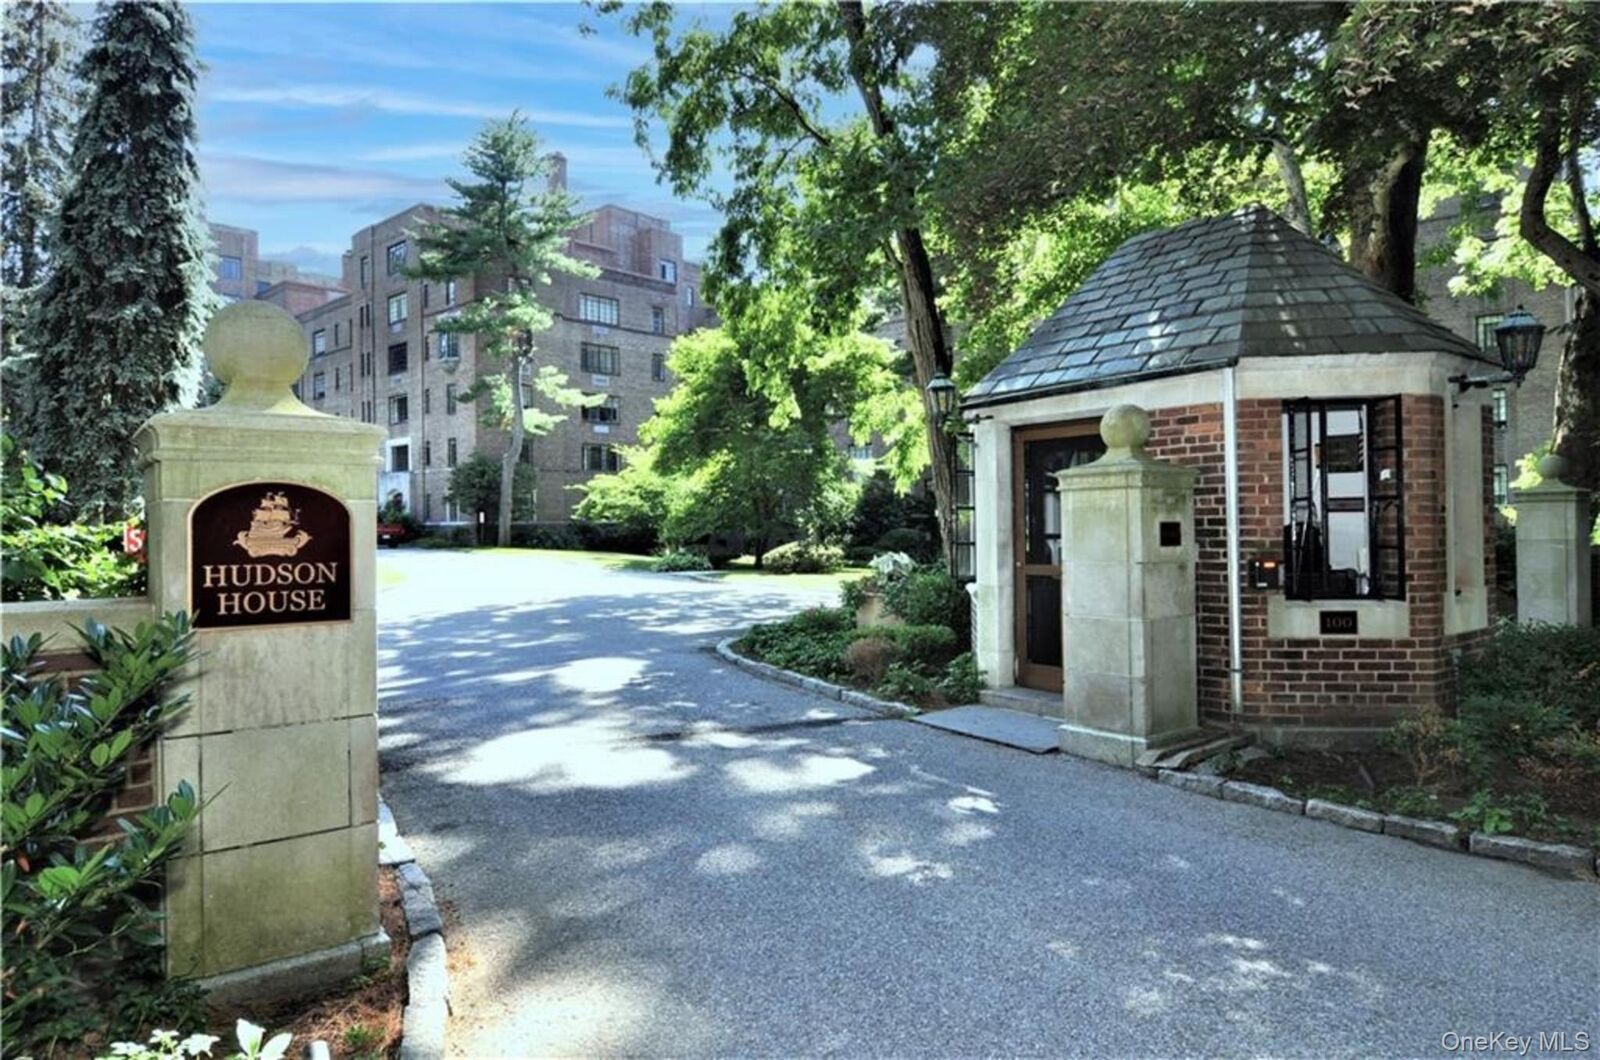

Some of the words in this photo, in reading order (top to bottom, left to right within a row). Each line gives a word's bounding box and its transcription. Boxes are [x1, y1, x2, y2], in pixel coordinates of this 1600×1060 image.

[203, 562, 338, 587] HUDSON
[217, 590, 326, 615] HOUSE
[1326, 617, 1353, 628] 100
